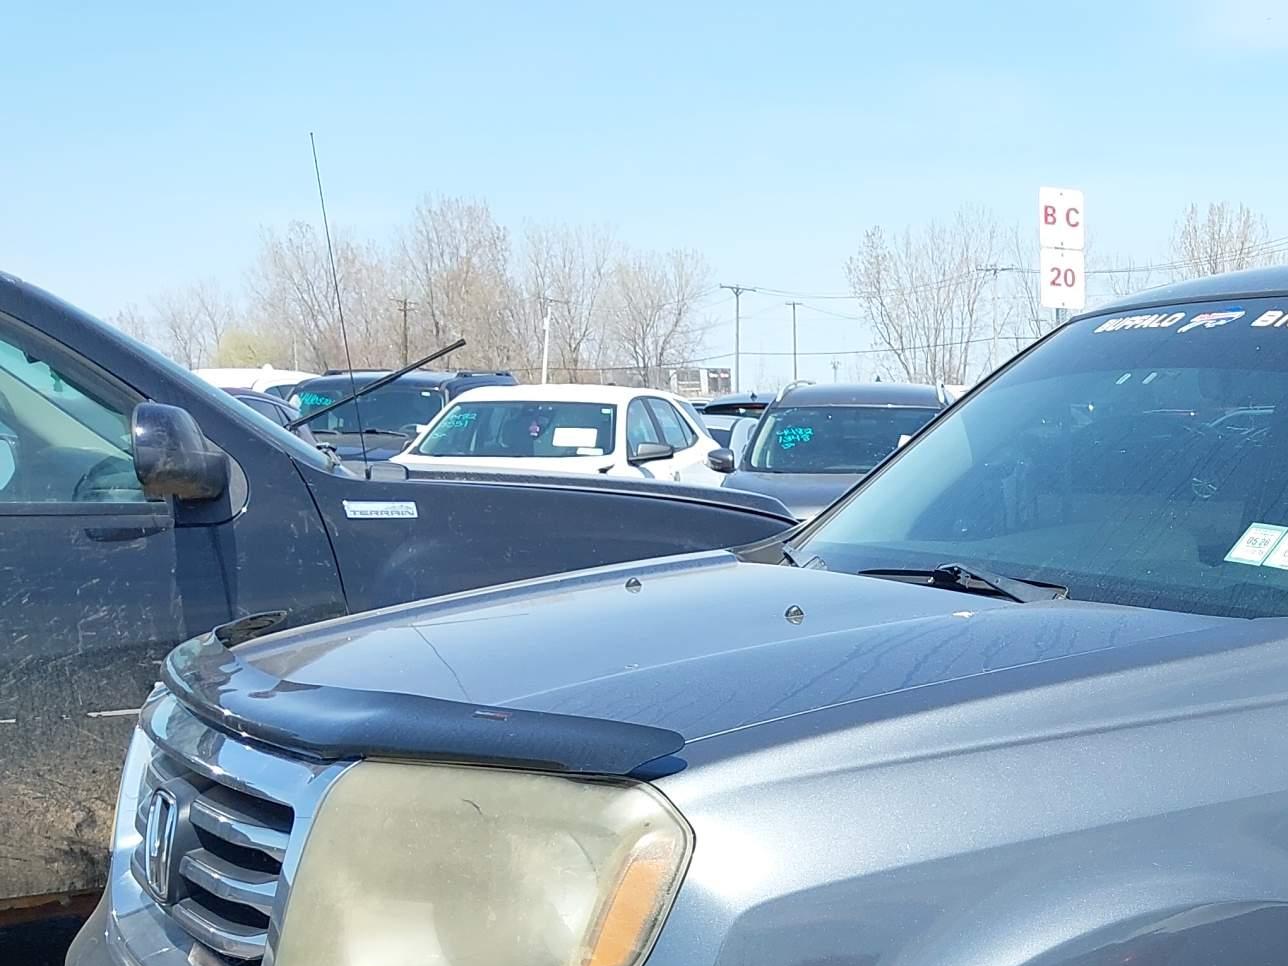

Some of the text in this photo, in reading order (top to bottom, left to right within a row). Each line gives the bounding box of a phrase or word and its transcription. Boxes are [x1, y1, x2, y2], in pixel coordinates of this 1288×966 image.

[1043, 205, 1080, 228] B C
[1049, 267, 1076, 288] 20
[1094, 311, 1187, 333] BUFFALO
